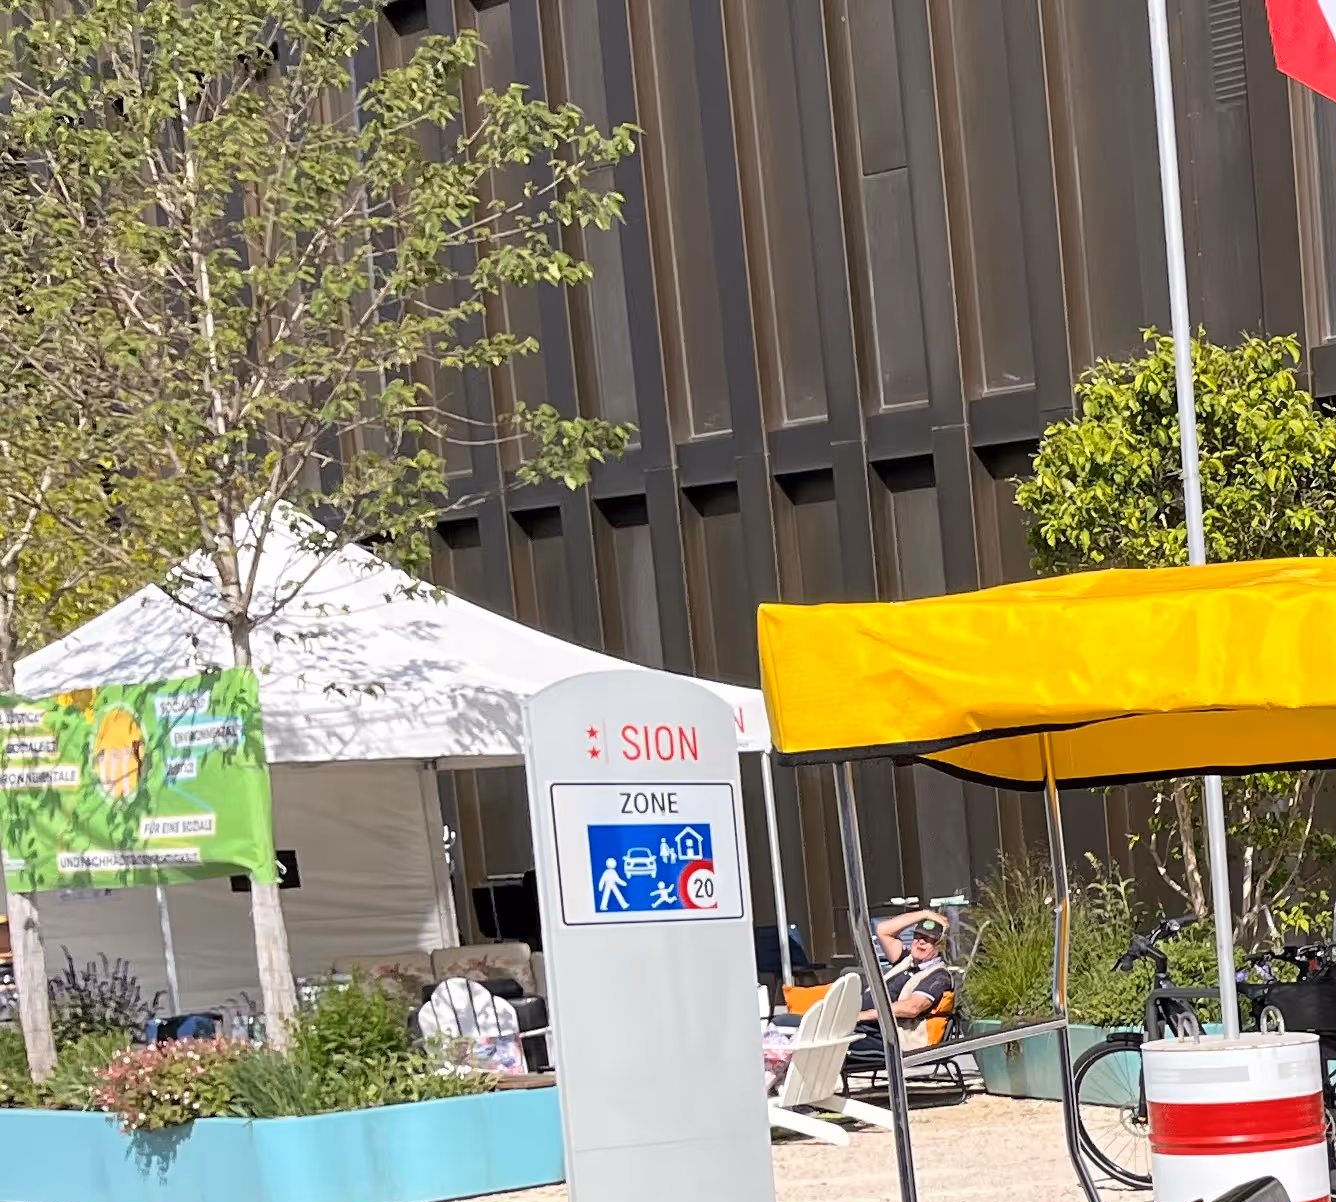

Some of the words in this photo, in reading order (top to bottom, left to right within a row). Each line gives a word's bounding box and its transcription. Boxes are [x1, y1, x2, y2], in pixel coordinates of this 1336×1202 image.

[619, 724, 699, 761] SION
[618, 792, 680, 814] ZONE
[692, 878, 715, 899] 20
